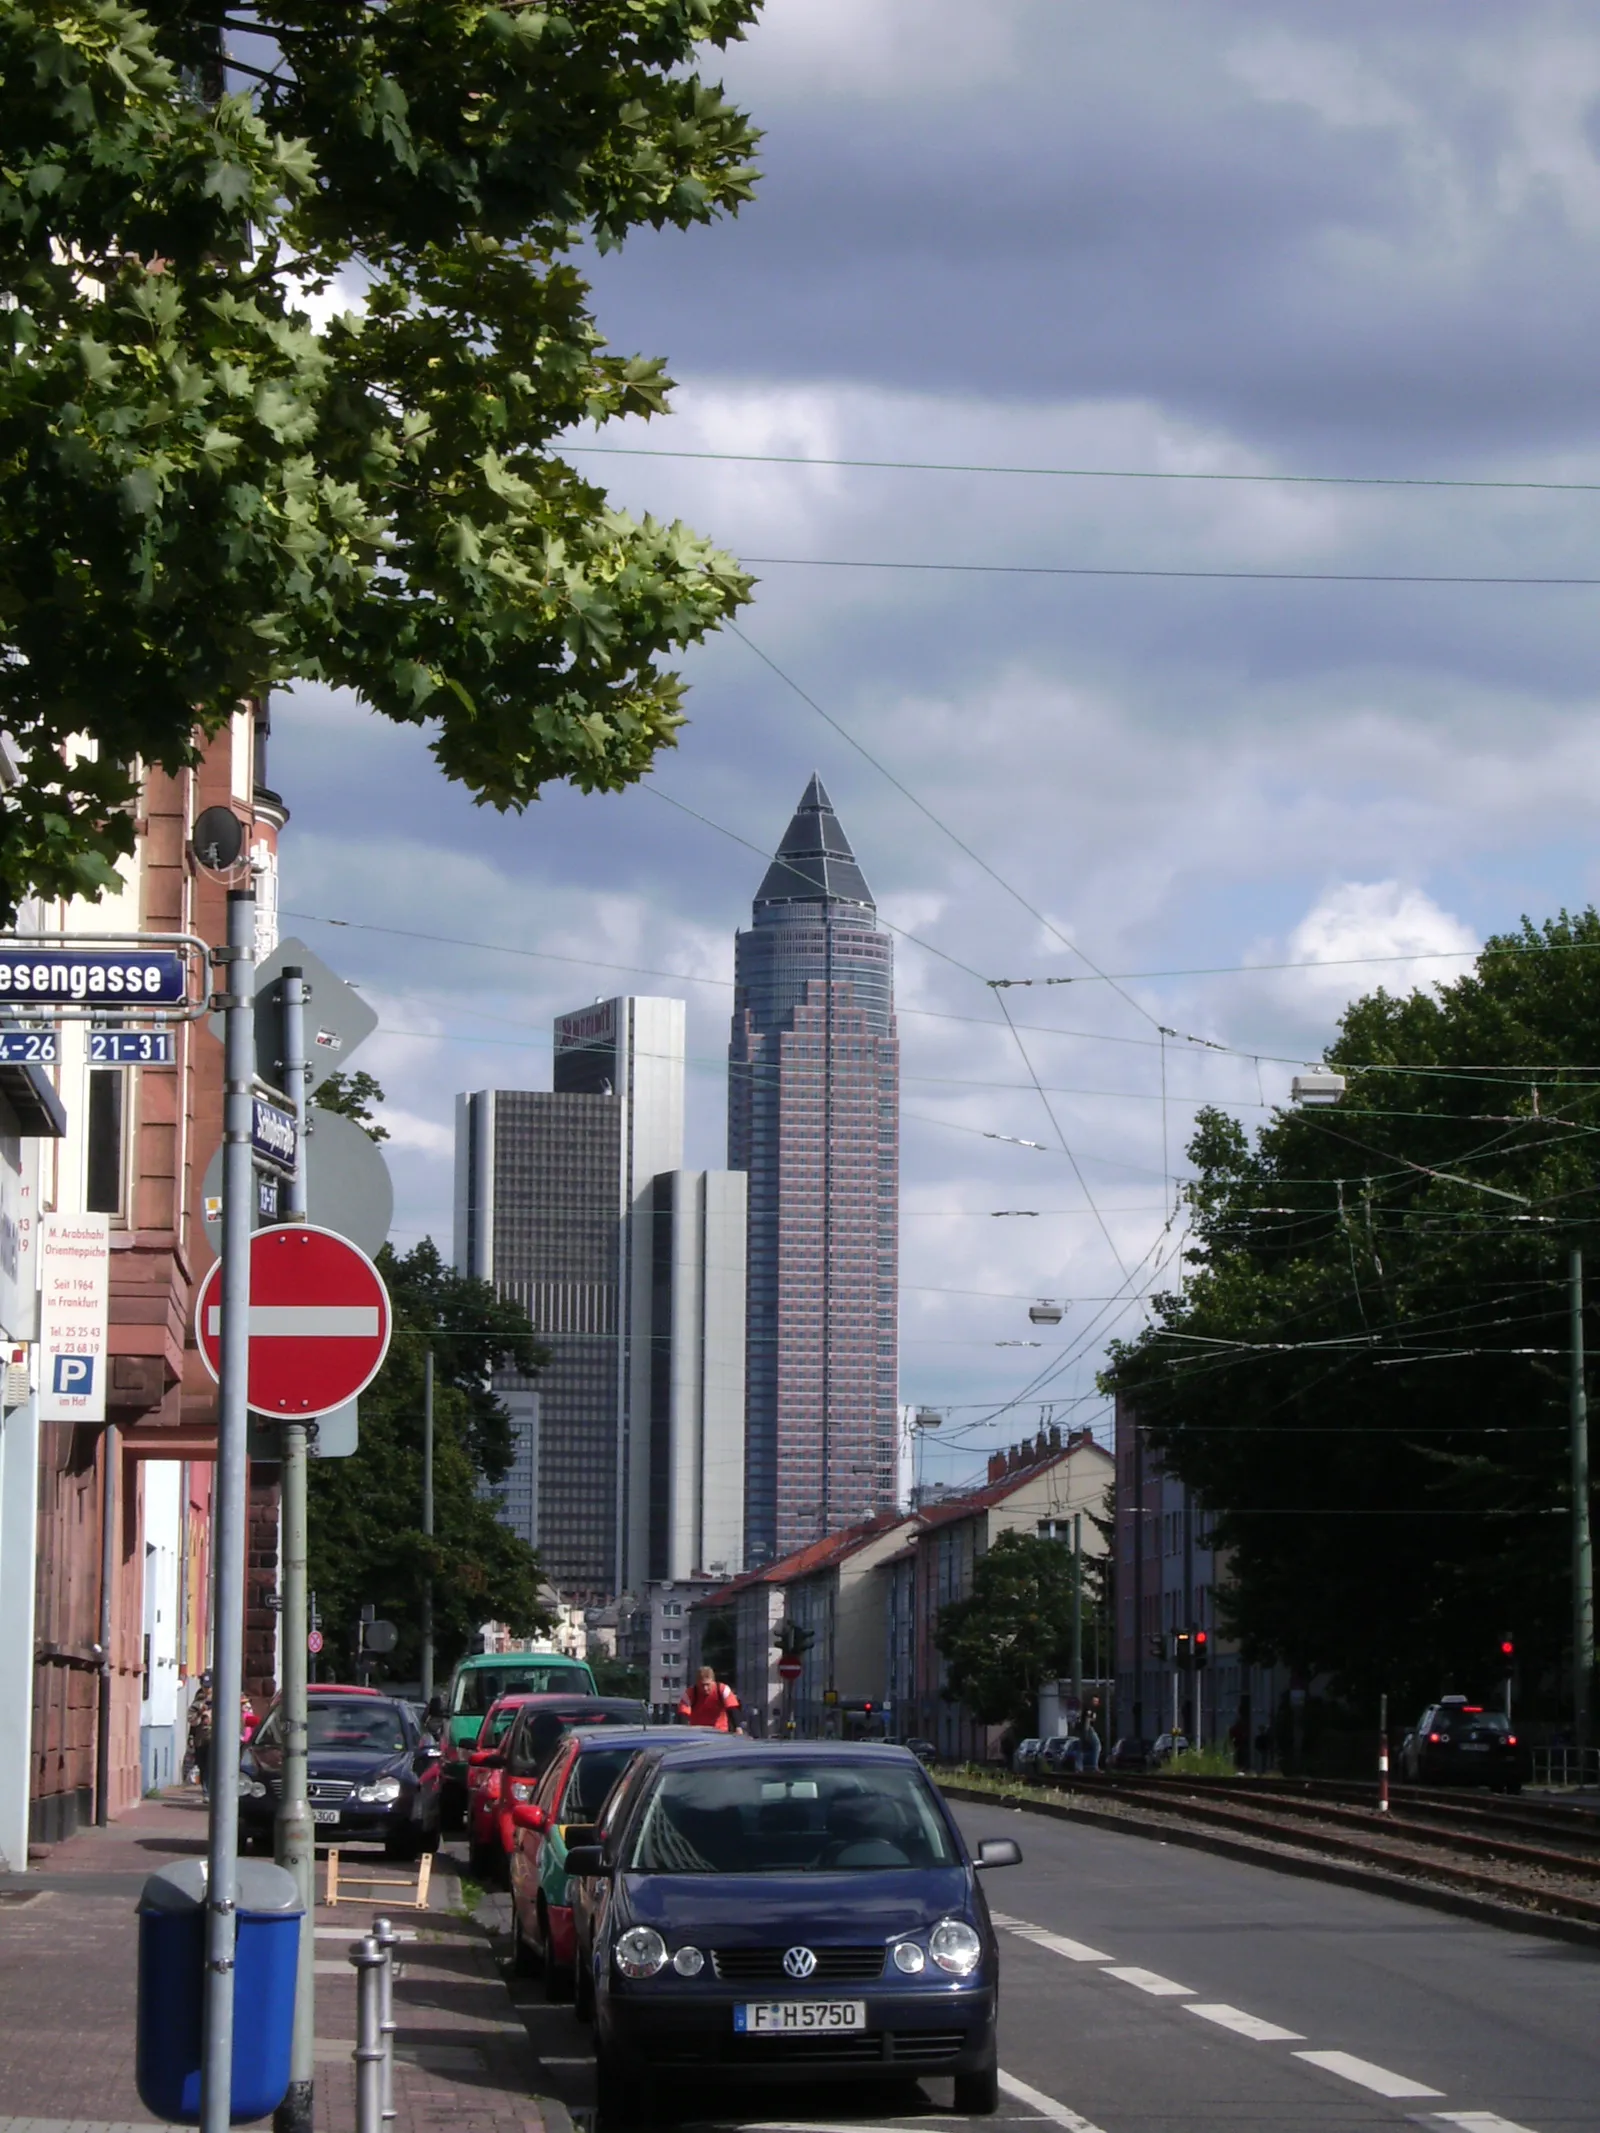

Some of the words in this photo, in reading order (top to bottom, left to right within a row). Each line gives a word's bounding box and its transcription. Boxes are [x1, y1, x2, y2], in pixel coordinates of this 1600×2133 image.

[0, 962, 161, 999] esengasse
[91, 1035, 166, 1061] 21-31
[48, 1227, 58, 1238] M.
[61, 1227, 105, 1240] Arabshahi
[45, 1244, 106, 1259] Orientteppiche
[54, 1278, 70, 1290] Seit
[73, 1279, 93, 1291] 1964
[48, 1296, 56, 1307] in
[58, 1296, 99, 1308] Frankfurt
[50, 1326, 63, 1337] Tel.
[66, 1327, 76, 1337] 25
[78, 1327, 88, 1337] 25
[91, 1327, 101, 1338] 43
[65, 1344, 75, 1353] 23
[89, 1344, 99, 1354] 19
[59, 1358, 87, 1392] P
[59, 1396, 70, 1407] im
[71, 1396, 87, 1407] Hof
[754, 2005, 769, 2027] F
[802, 2004, 856, 2027] 5750
